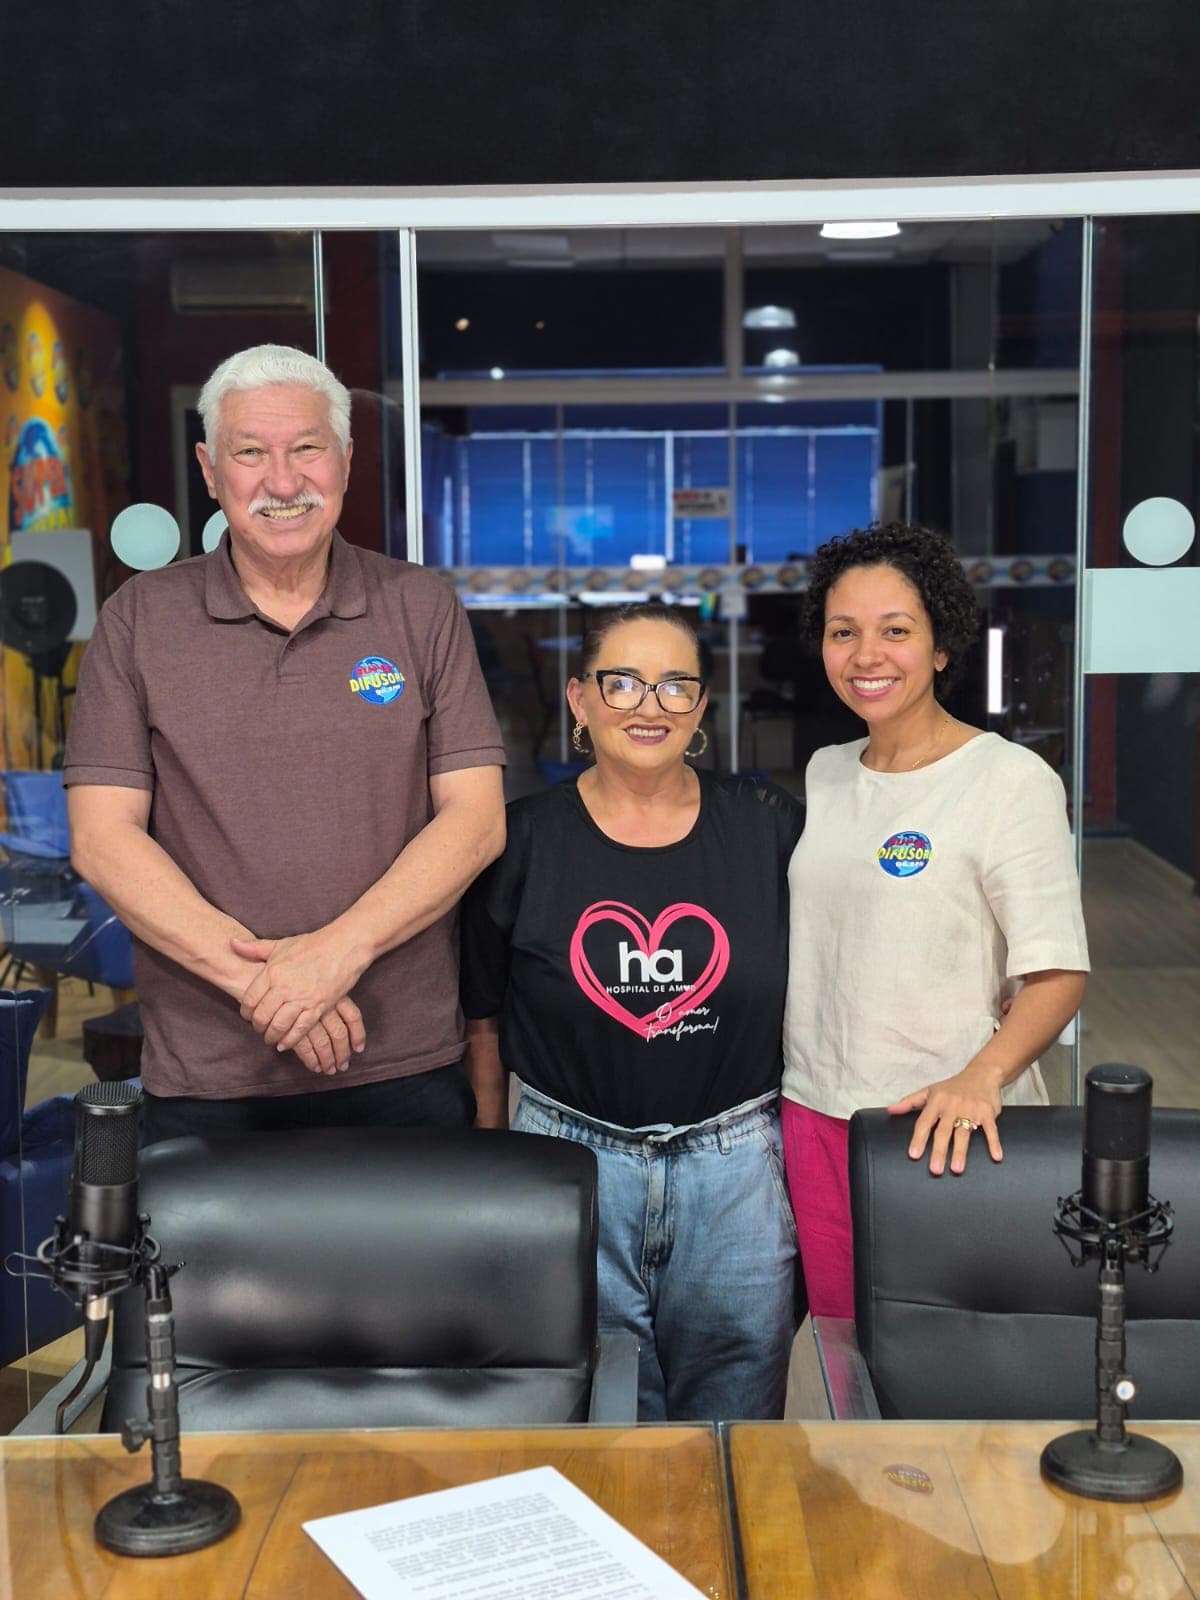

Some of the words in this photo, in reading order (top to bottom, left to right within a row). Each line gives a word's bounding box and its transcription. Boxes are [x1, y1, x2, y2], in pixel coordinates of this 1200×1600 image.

[618, 941, 683, 983] ha
[606, 985, 650, 994] HOSPITAL
[653, 985, 666, 993] DE
[655, 1002, 672, 1023] O
[678, 1006, 711, 1017] amor
[643, 1016, 720, 1043] transforma!
